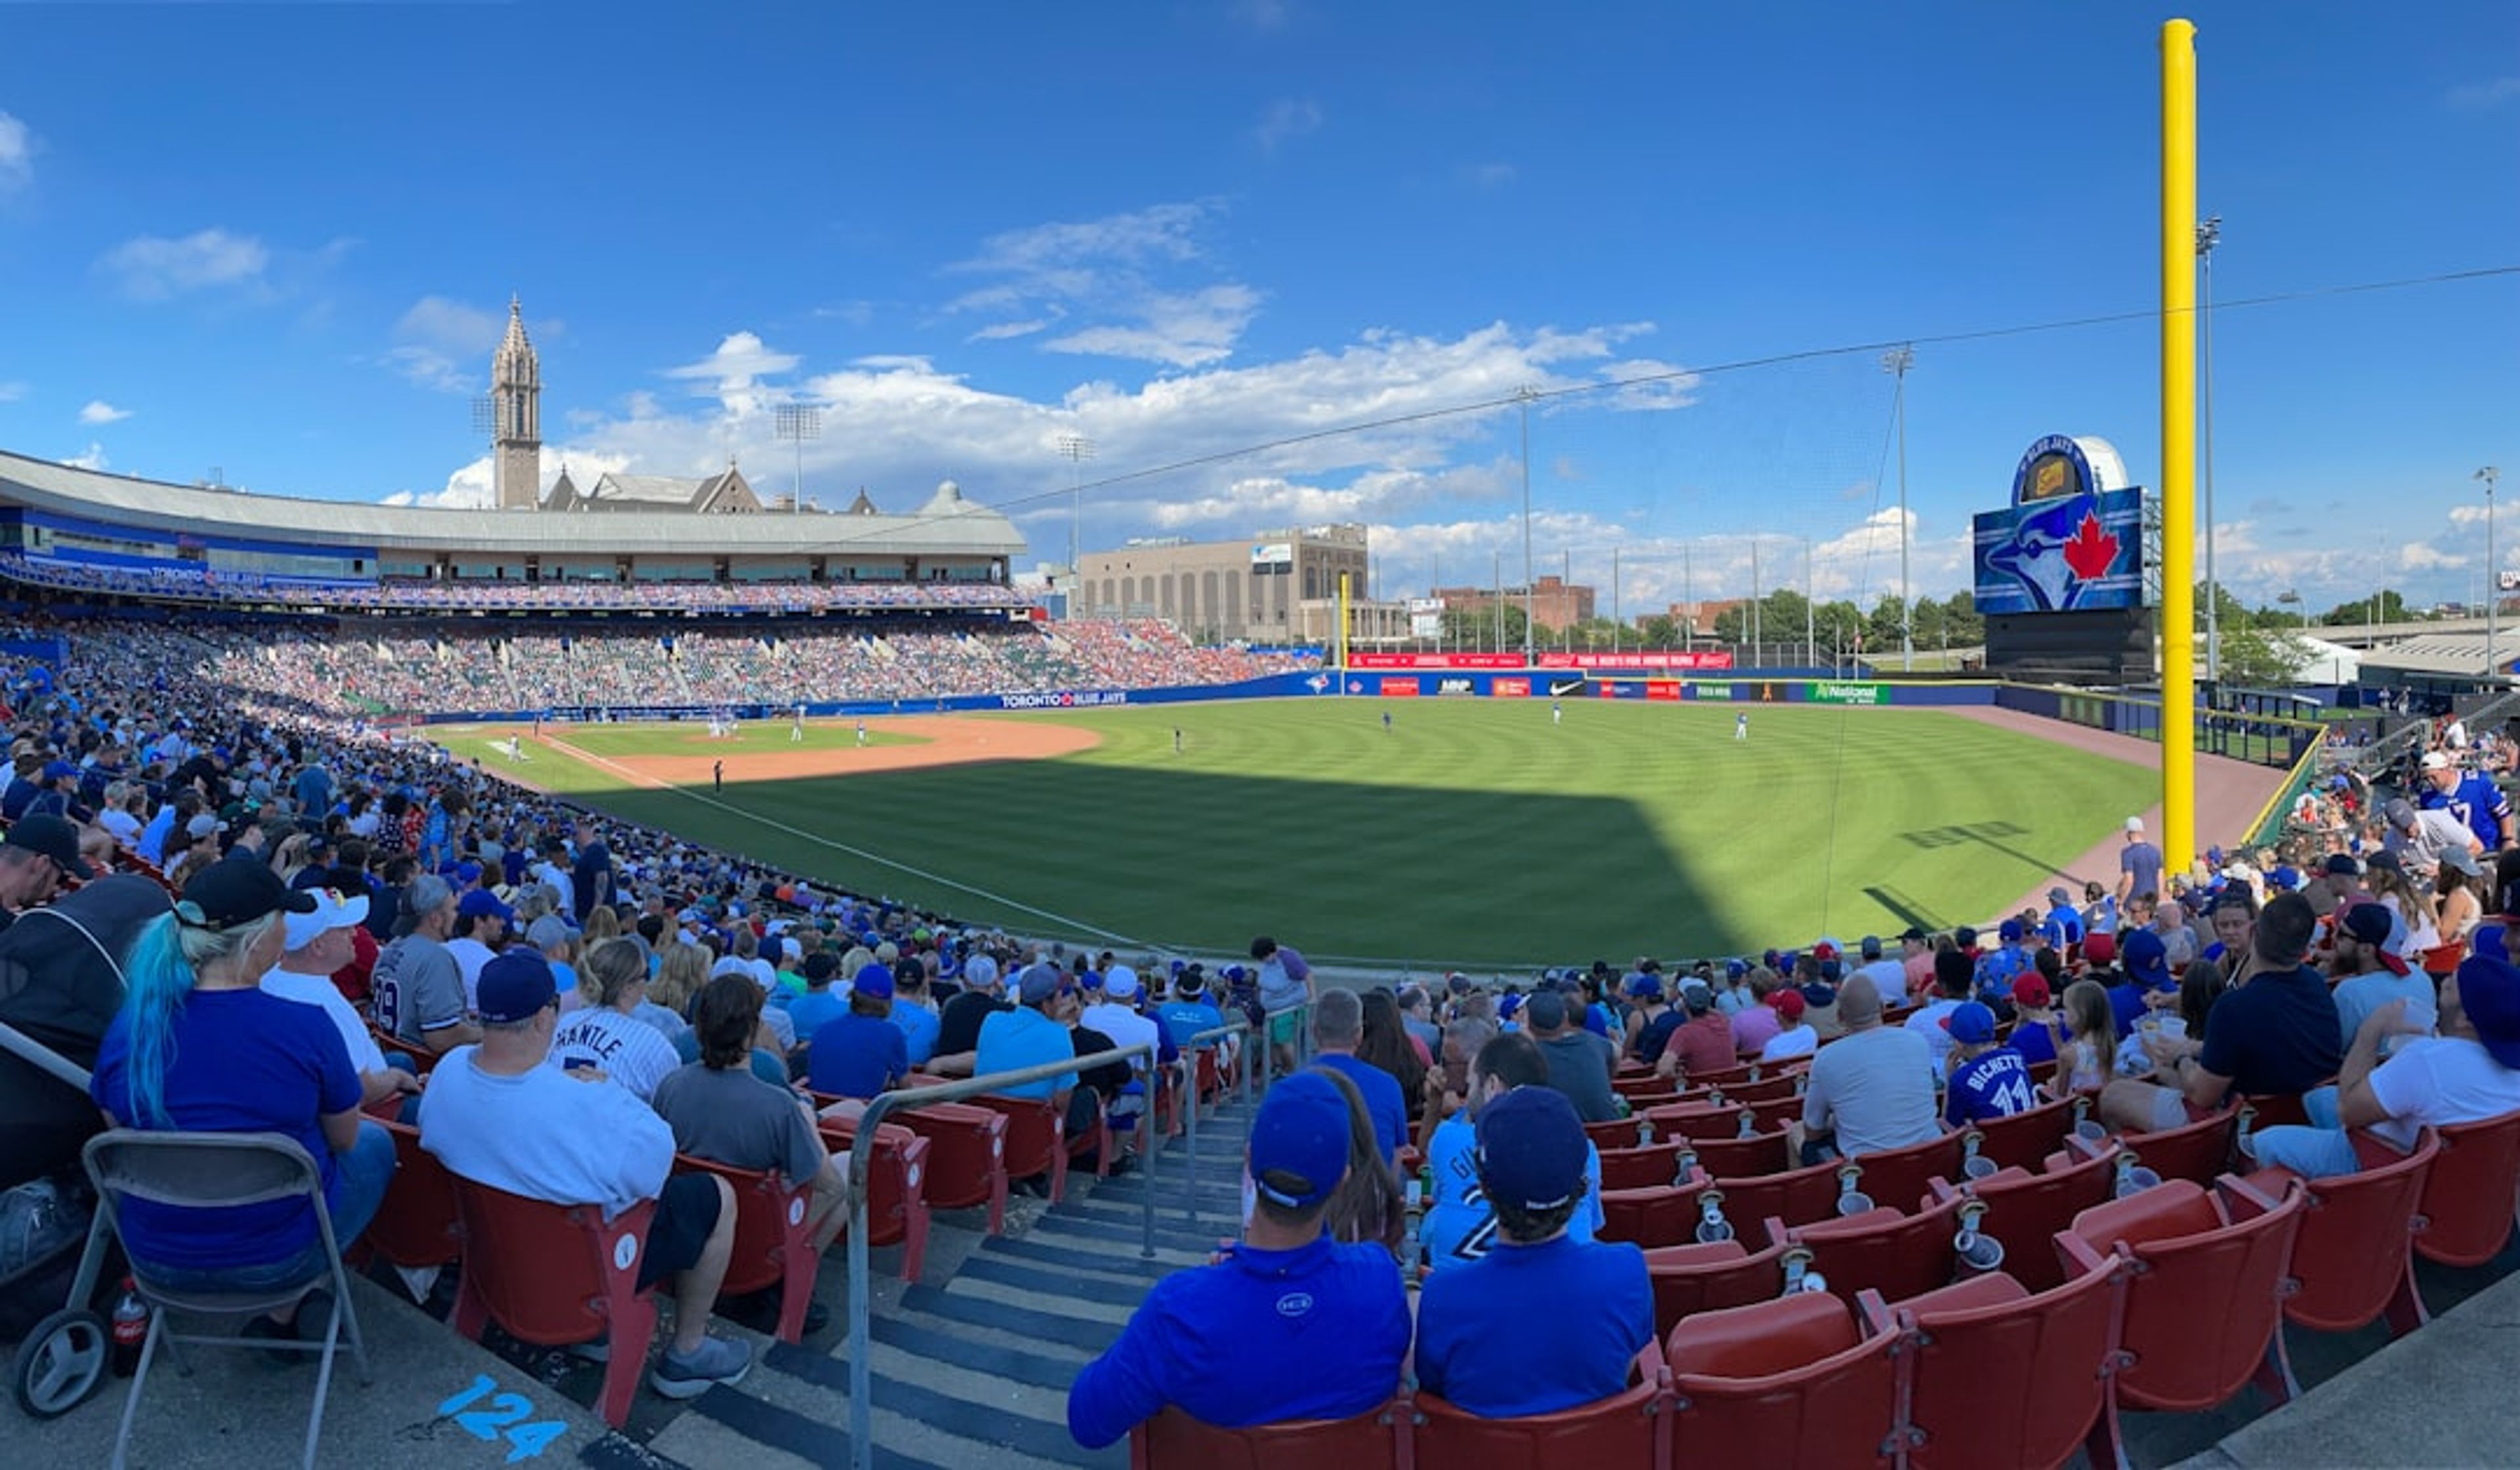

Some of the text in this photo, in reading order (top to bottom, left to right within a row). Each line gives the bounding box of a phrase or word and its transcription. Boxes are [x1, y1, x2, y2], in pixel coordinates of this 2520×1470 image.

[1002, 692, 1126, 707] TORONTO BLUE JAYS
[1830, 685, 1877, 698] National
[1990, 1074, 2032, 1117] 11
[437, 1373, 569, 1464] 124
